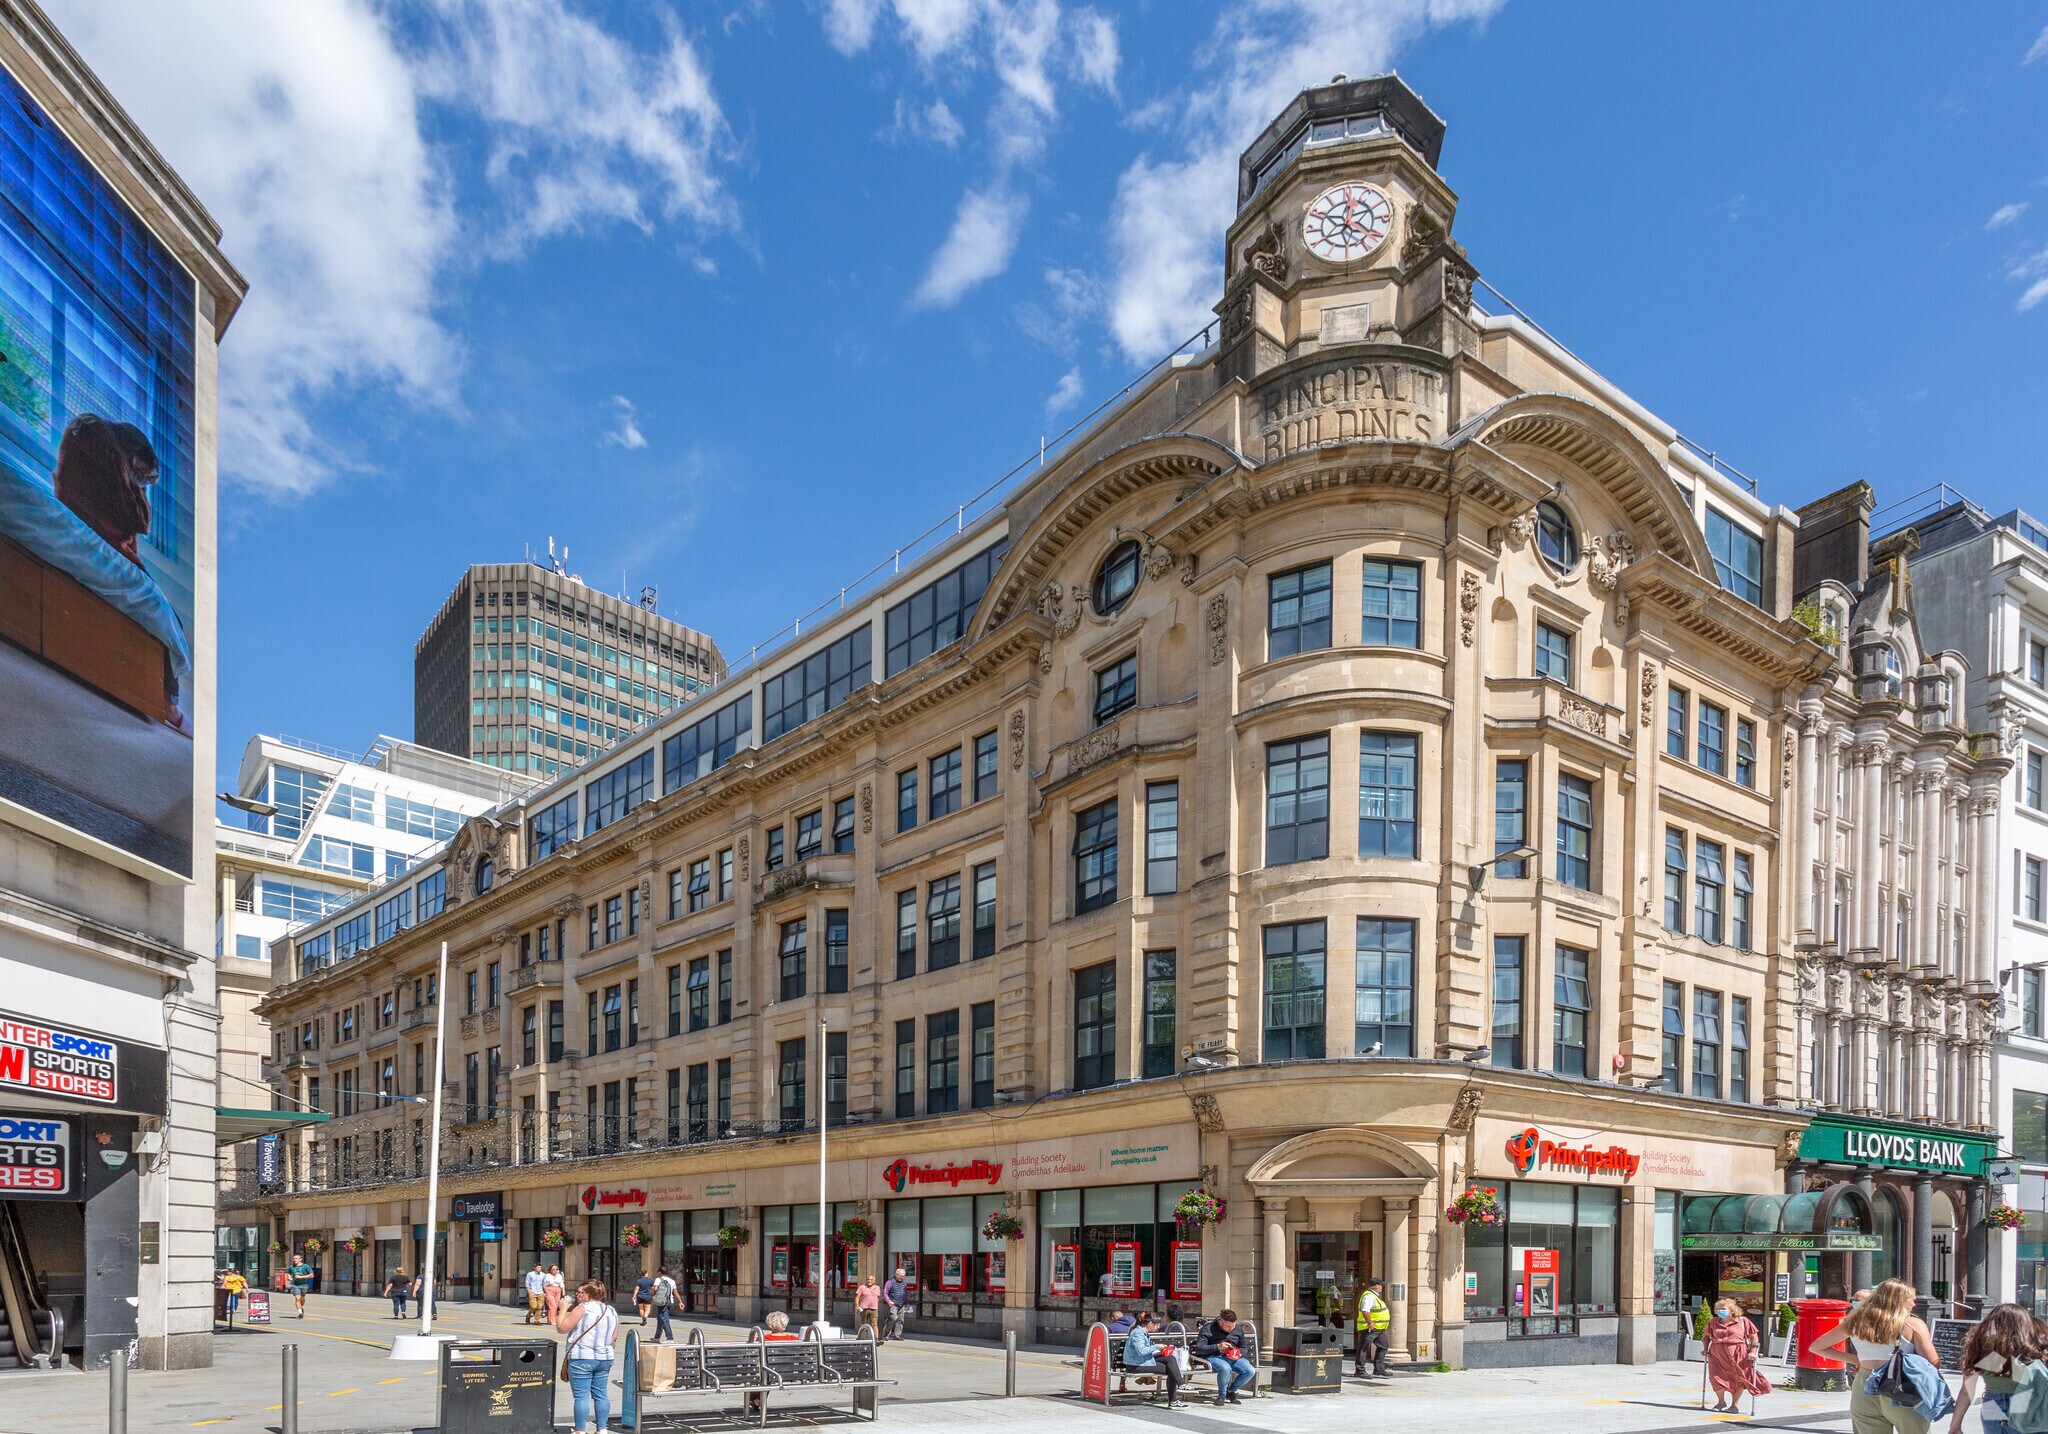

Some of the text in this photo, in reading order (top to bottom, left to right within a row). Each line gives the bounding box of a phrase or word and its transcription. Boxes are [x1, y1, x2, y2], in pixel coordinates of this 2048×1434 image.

[1263, 408, 1432, 463] BUILDINGS
[34, 1051, 111, 1080] SPORTS
[35, 1071, 111, 1099] STORES
[1129, 1147, 1146, 1155] home
[1847, 1130, 1965, 1167] LLOYDS BANK
[262, 1141, 275, 1181] Travelodge
[1011, 1153, 1067, 1166] Building Society
[1110, 1155, 1157, 1167] principality.co.uk
[1539, 1140, 1641, 1178] Principality
[1643, 1150, 1691, 1164] Building Society
[908, 1159, 1003, 1188] Principality
[1012, 1163, 1086, 1178] Cymdeithas Adeiladu
[1643, 1163, 1706, 1177] Cymdeithas Adeiladu
[651, 1185, 683, 1195] Building Society
[465, 1200, 495, 1215] Travelodge
[1713, 1236, 1772, 1248] Restaurant
